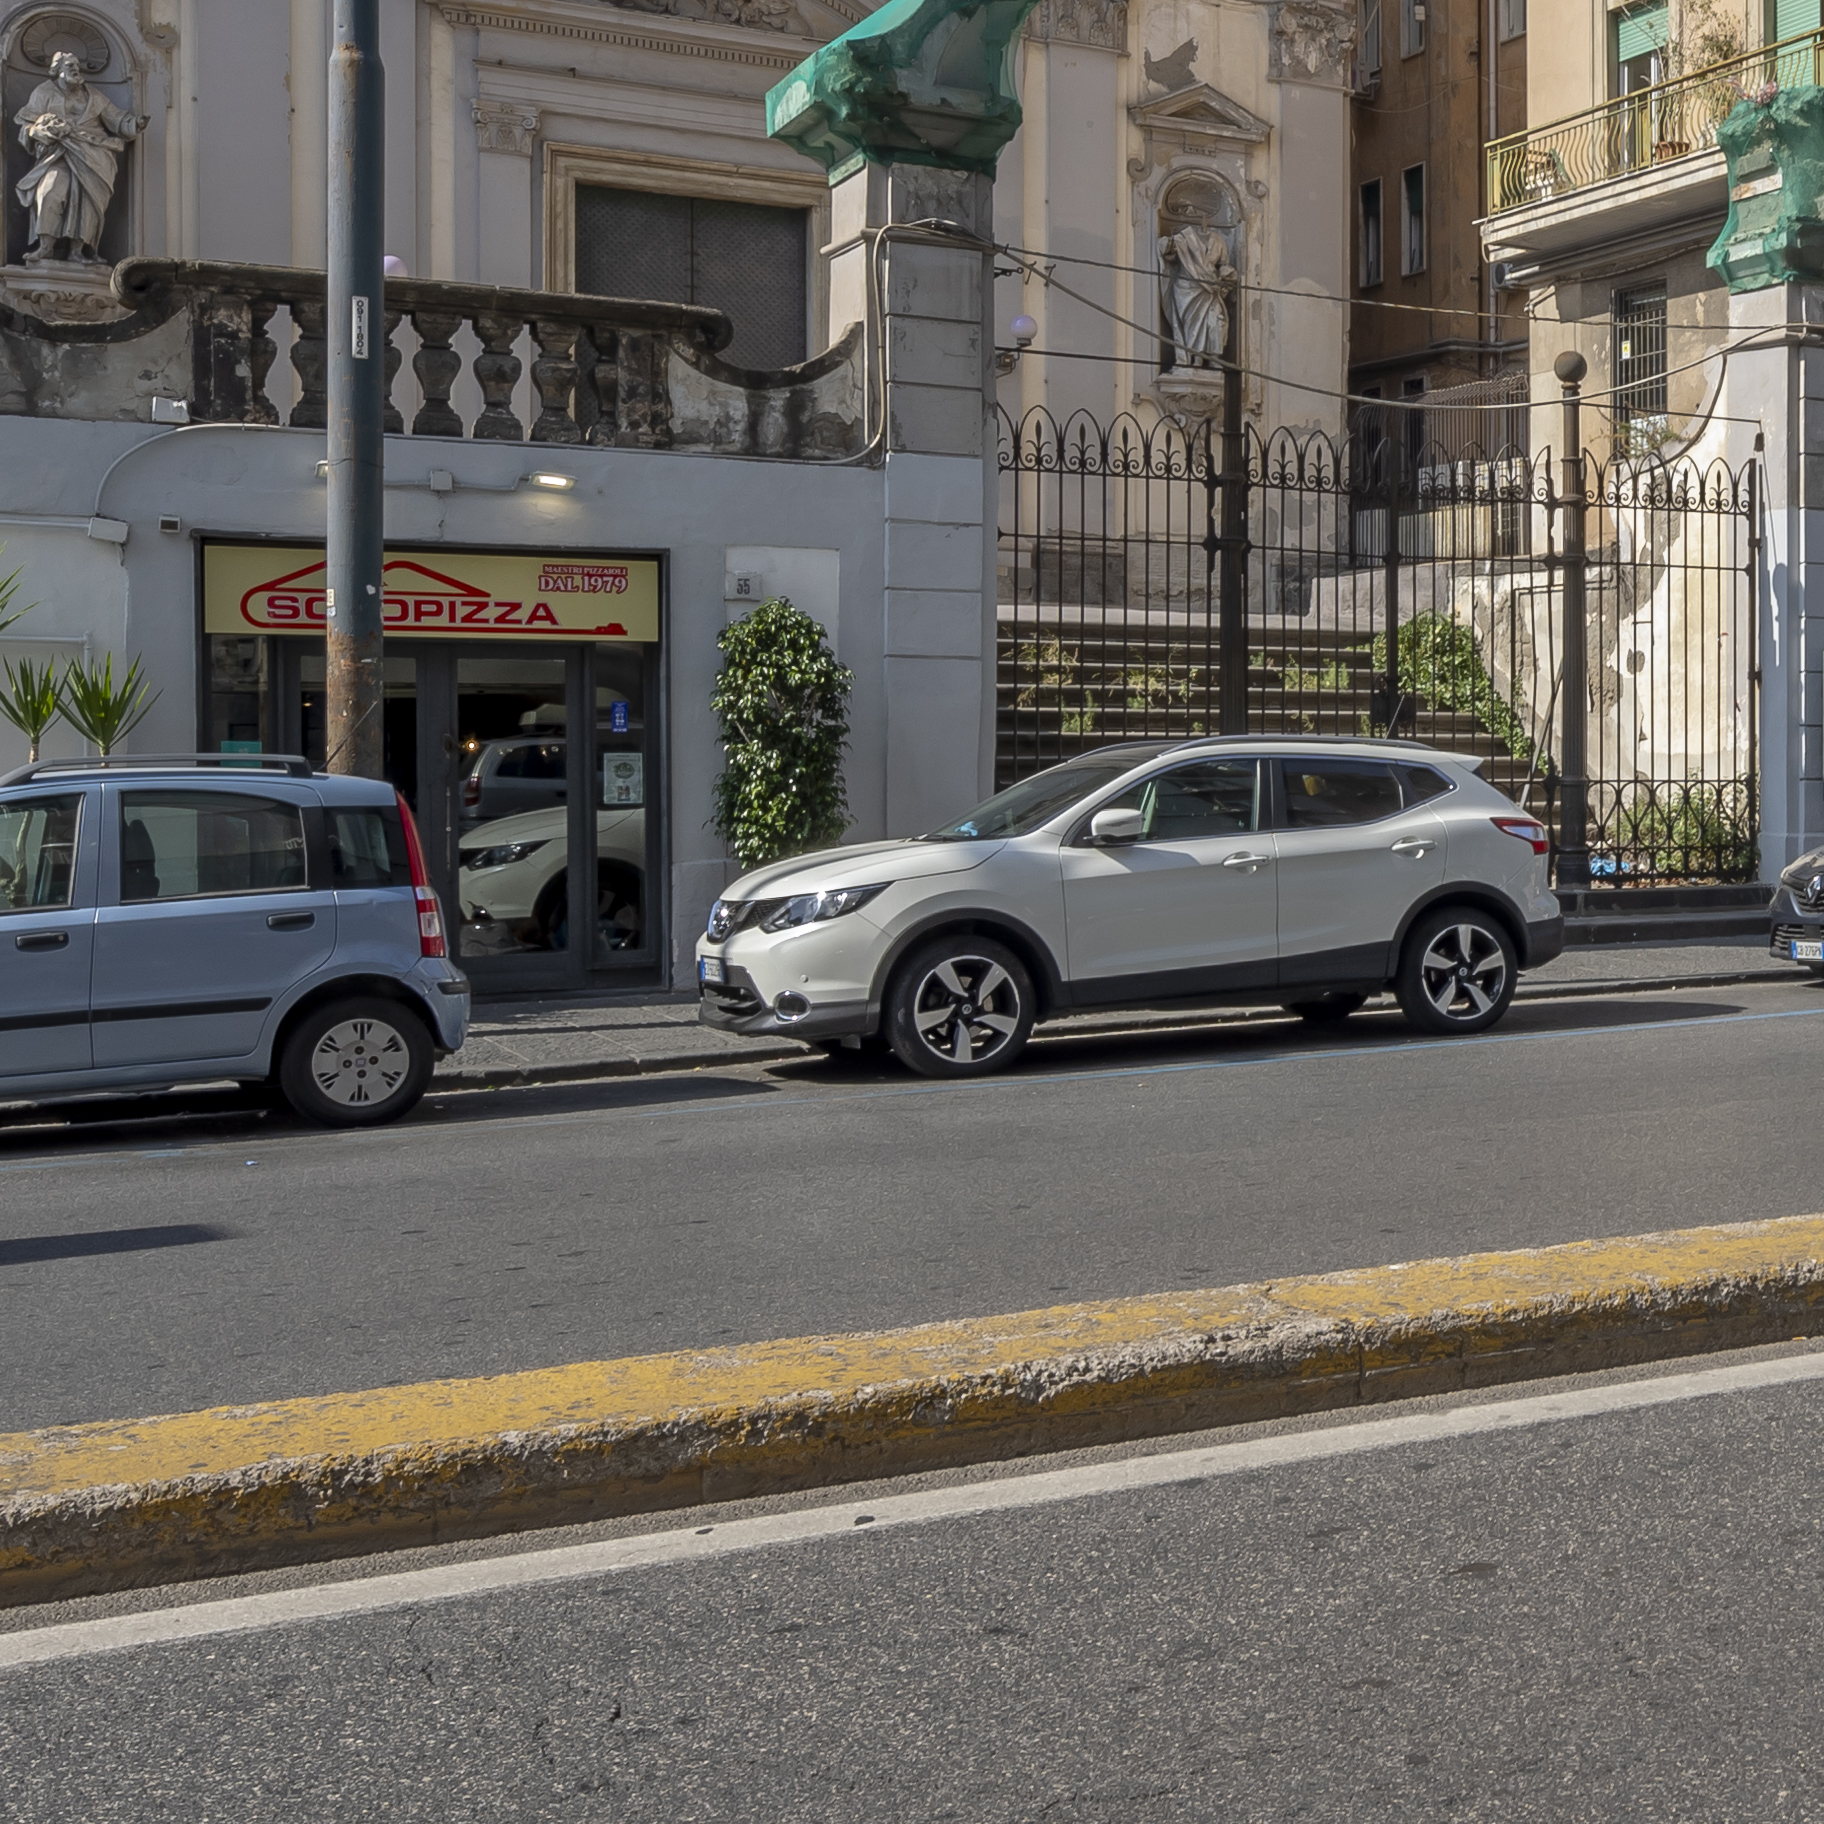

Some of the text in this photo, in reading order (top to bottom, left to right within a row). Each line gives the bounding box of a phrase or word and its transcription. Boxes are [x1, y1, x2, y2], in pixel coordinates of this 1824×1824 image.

[540, 576, 627, 593] DAL 1979
[736, 578, 750, 595] 55
